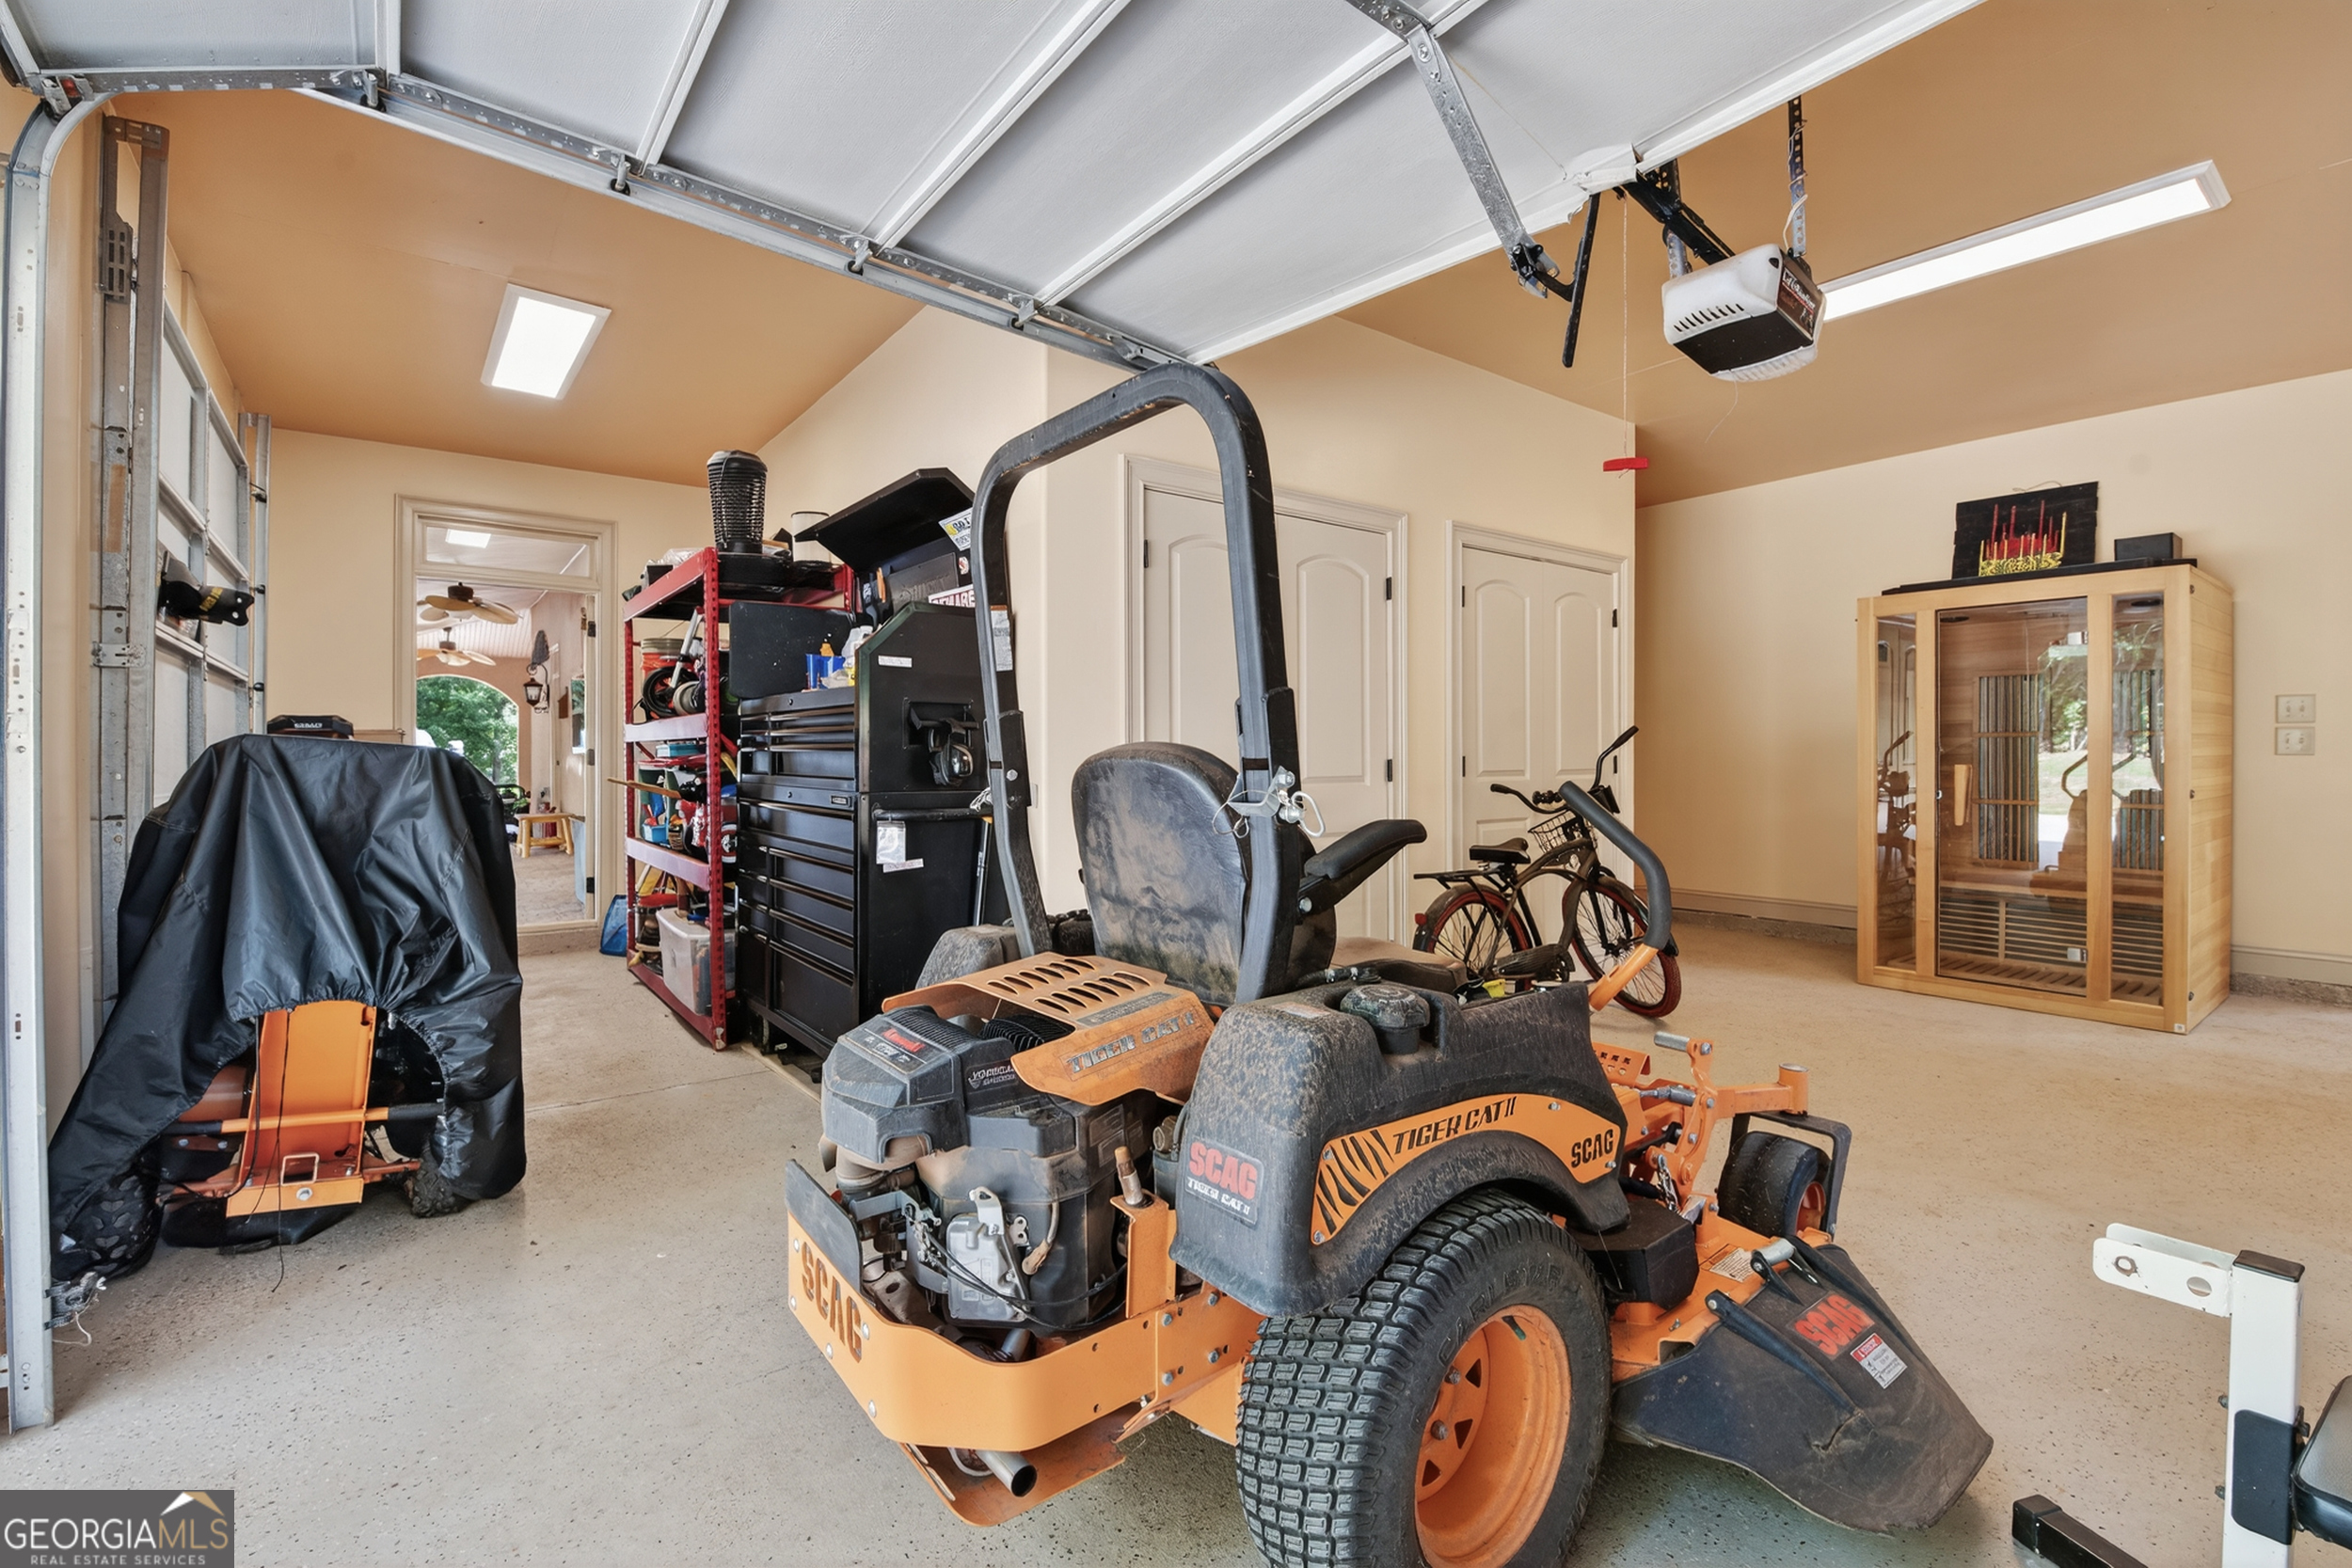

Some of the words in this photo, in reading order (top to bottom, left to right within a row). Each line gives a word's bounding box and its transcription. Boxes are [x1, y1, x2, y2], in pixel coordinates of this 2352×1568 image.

[1392, 1115, 1462, 1156] TIGER
[1465, 1099, 1506, 1131] CAT
[1570, 1129, 1614, 1168] SCAG
[1186, 1176, 1220, 1200] TIGER
[1188, 1141, 1258, 1200] SCAG
[801, 1241, 863, 1364] SCAG
[1794, 1293, 1875, 1355] SCAG
